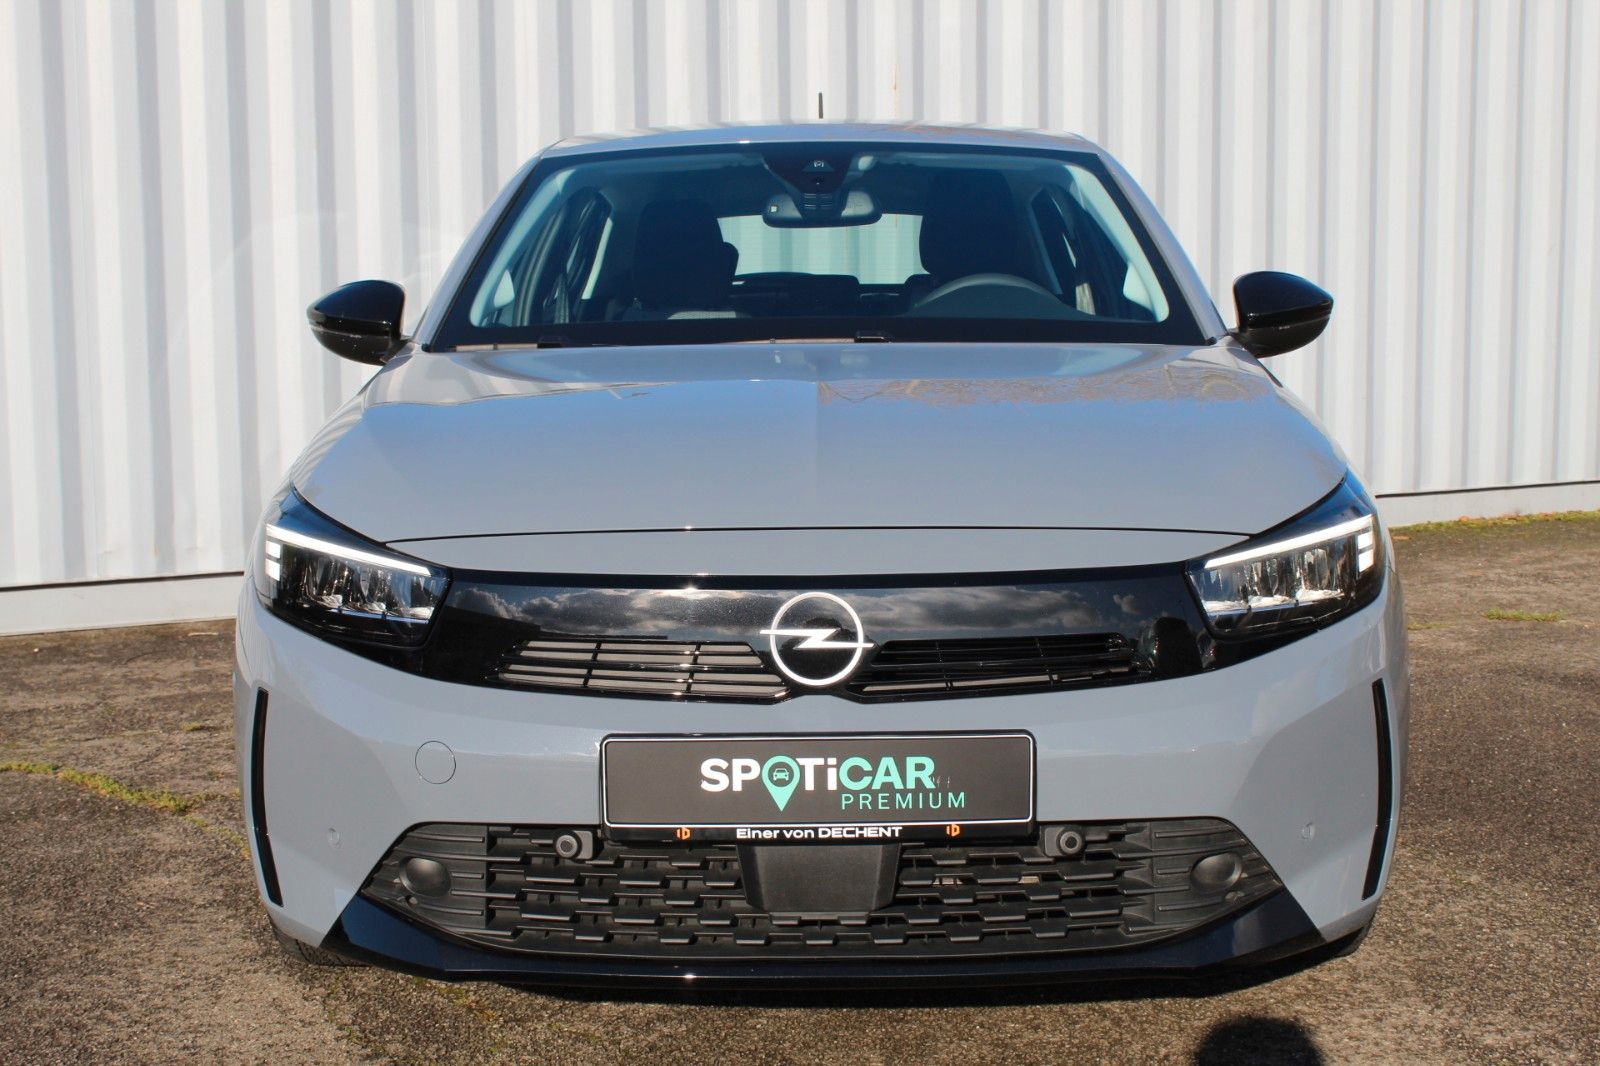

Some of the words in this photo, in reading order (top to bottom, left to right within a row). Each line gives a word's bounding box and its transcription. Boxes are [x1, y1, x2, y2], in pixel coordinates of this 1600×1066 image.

[700, 755, 936, 811] SPOTiCAR
[841, 791, 965, 811] PREMIUM
[736, 827, 777, 839] Einer
[784, 829, 815, 839] von
[818, 826, 903, 839] DECHENT
